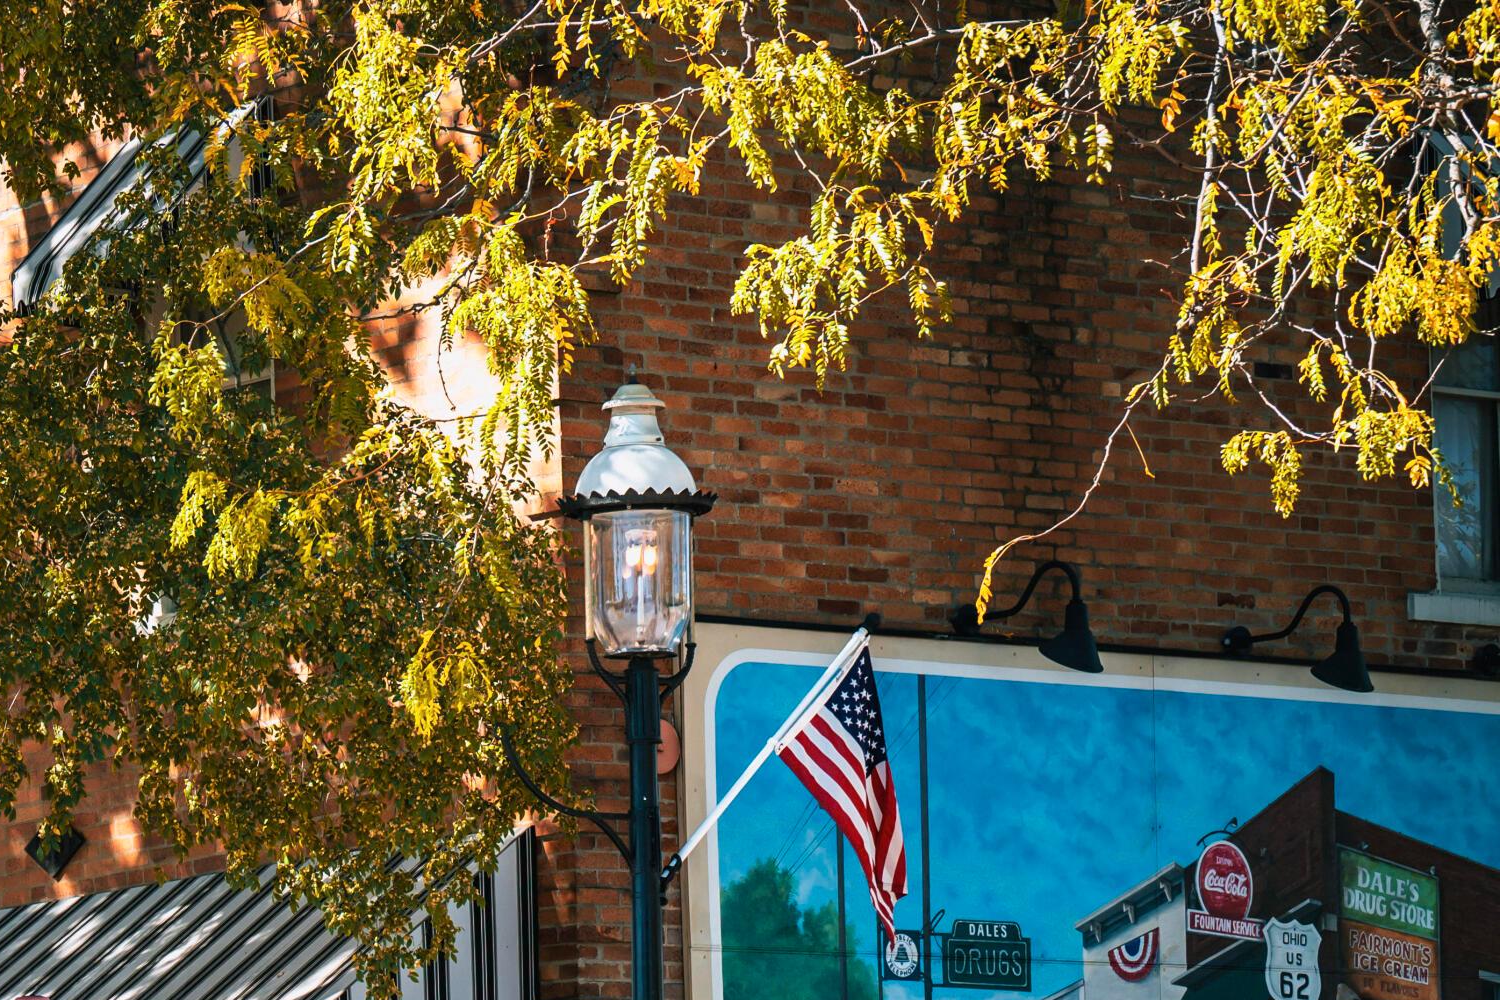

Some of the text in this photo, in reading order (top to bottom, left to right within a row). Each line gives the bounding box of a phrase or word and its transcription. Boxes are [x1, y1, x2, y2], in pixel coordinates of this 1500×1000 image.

[1357, 865, 1420, 902] DALE'S
[1343, 886, 1435, 930] DRUG STORE
[1194, 914, 1261, 938] FOUNTAIN SERVICE
[1282, 931, 1308, 947] OHIO
[954, 948, 1022, 976] DRUGS
[1286, 952, 1303, 966] US
[1350, 930, 1432, 966] FAIRMONT'S
[1354, 953, 1430, 985] ICE CREAM
[1279, 972, 1310, 1000] 62
